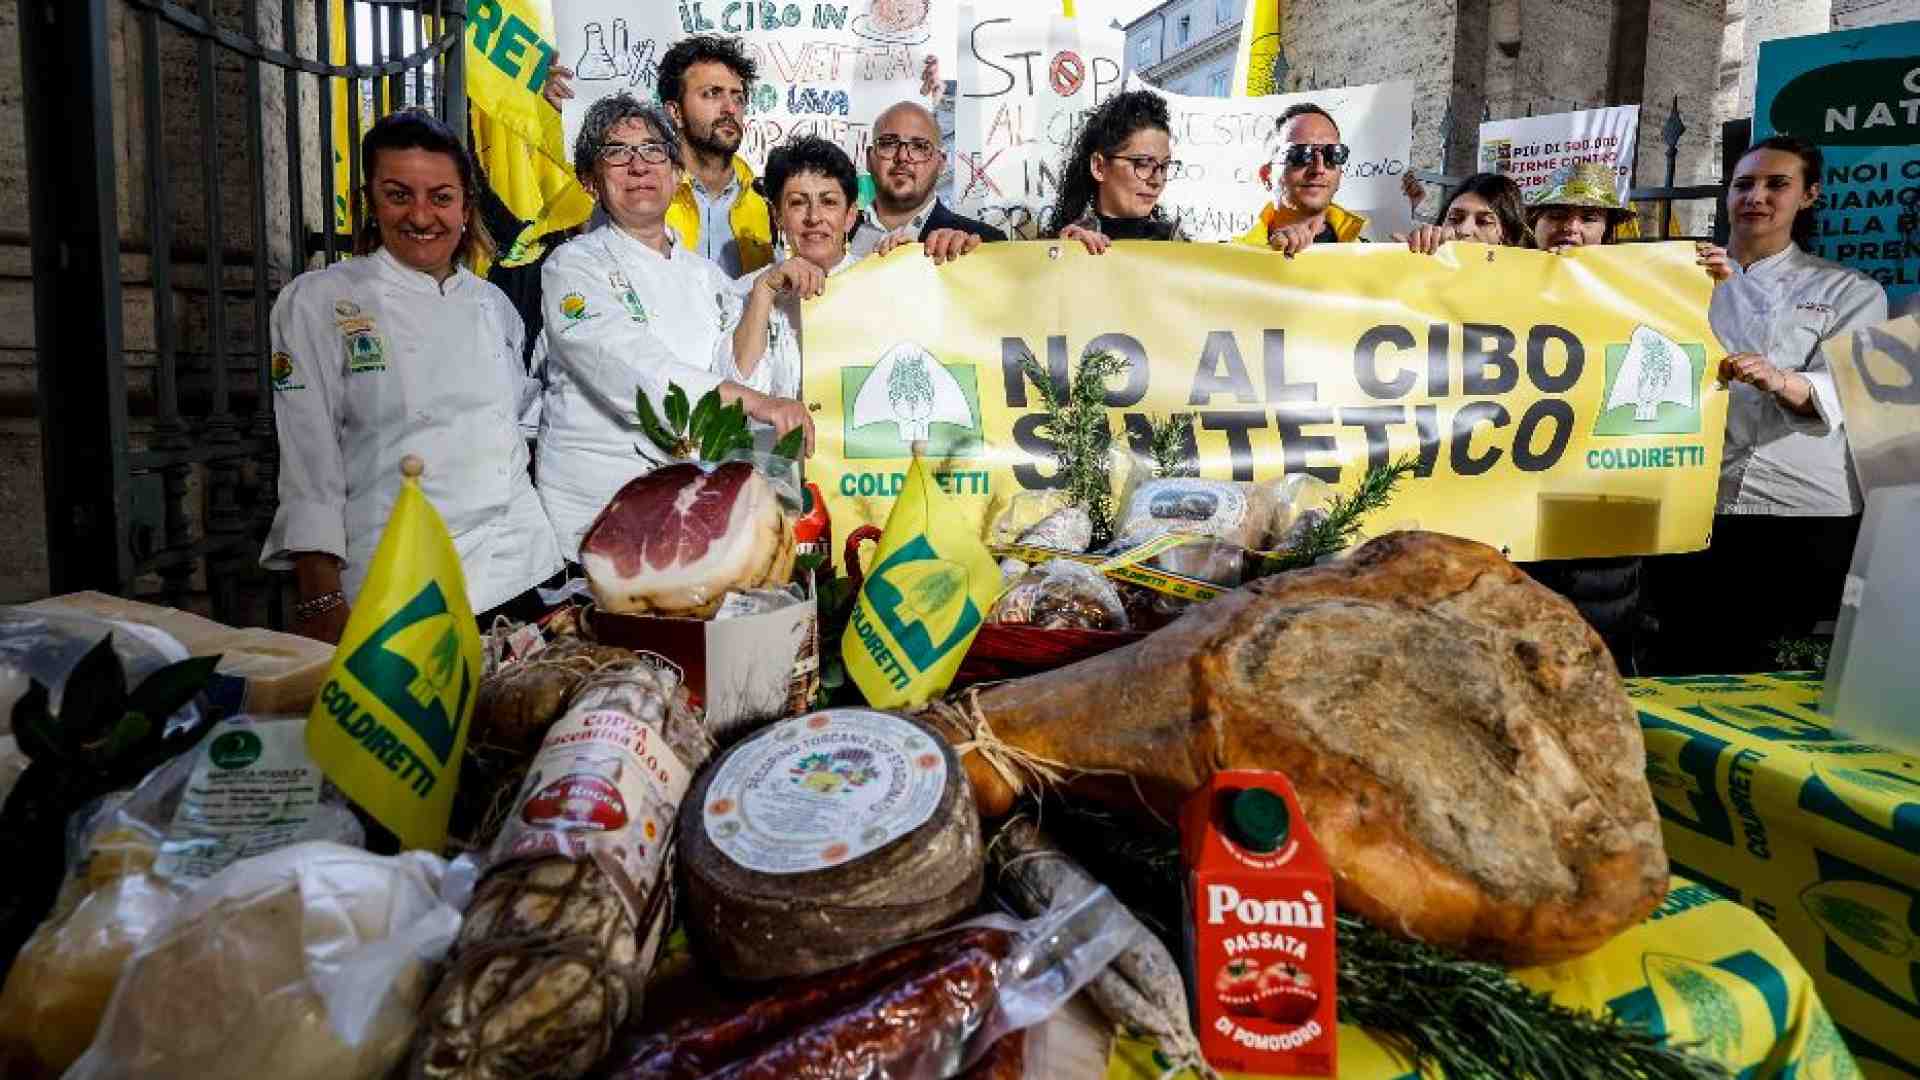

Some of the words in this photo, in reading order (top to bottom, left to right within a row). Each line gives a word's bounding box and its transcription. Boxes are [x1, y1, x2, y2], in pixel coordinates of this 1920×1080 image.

[720, 0, 801, 33] CIBO
[812, 3, 849, 30] IN
[985, 102, 1037, 146] AL
[1511, 158, 1557, 174] FIRME
[1001, 332, 1150, 408] NO
[1189, 329, 1318, 406] AL
[1354, 323, 1585, 400] CIBO
[1012, 398, 1576, 490] SNTETICO
[1586, 445, 1706, 470] COLDIRETTI
[839, 471, 990, 496] COLDETTI
[320, 679, 437, 799] COLDIRETTI
[1207, 884, 1325, 929] Pomì
[1223, 932, 1308, 961] PASSATA
[1215, 1016, 1235, 1036] DI
[1232, 1020, 1322, 1052] POMODORO
